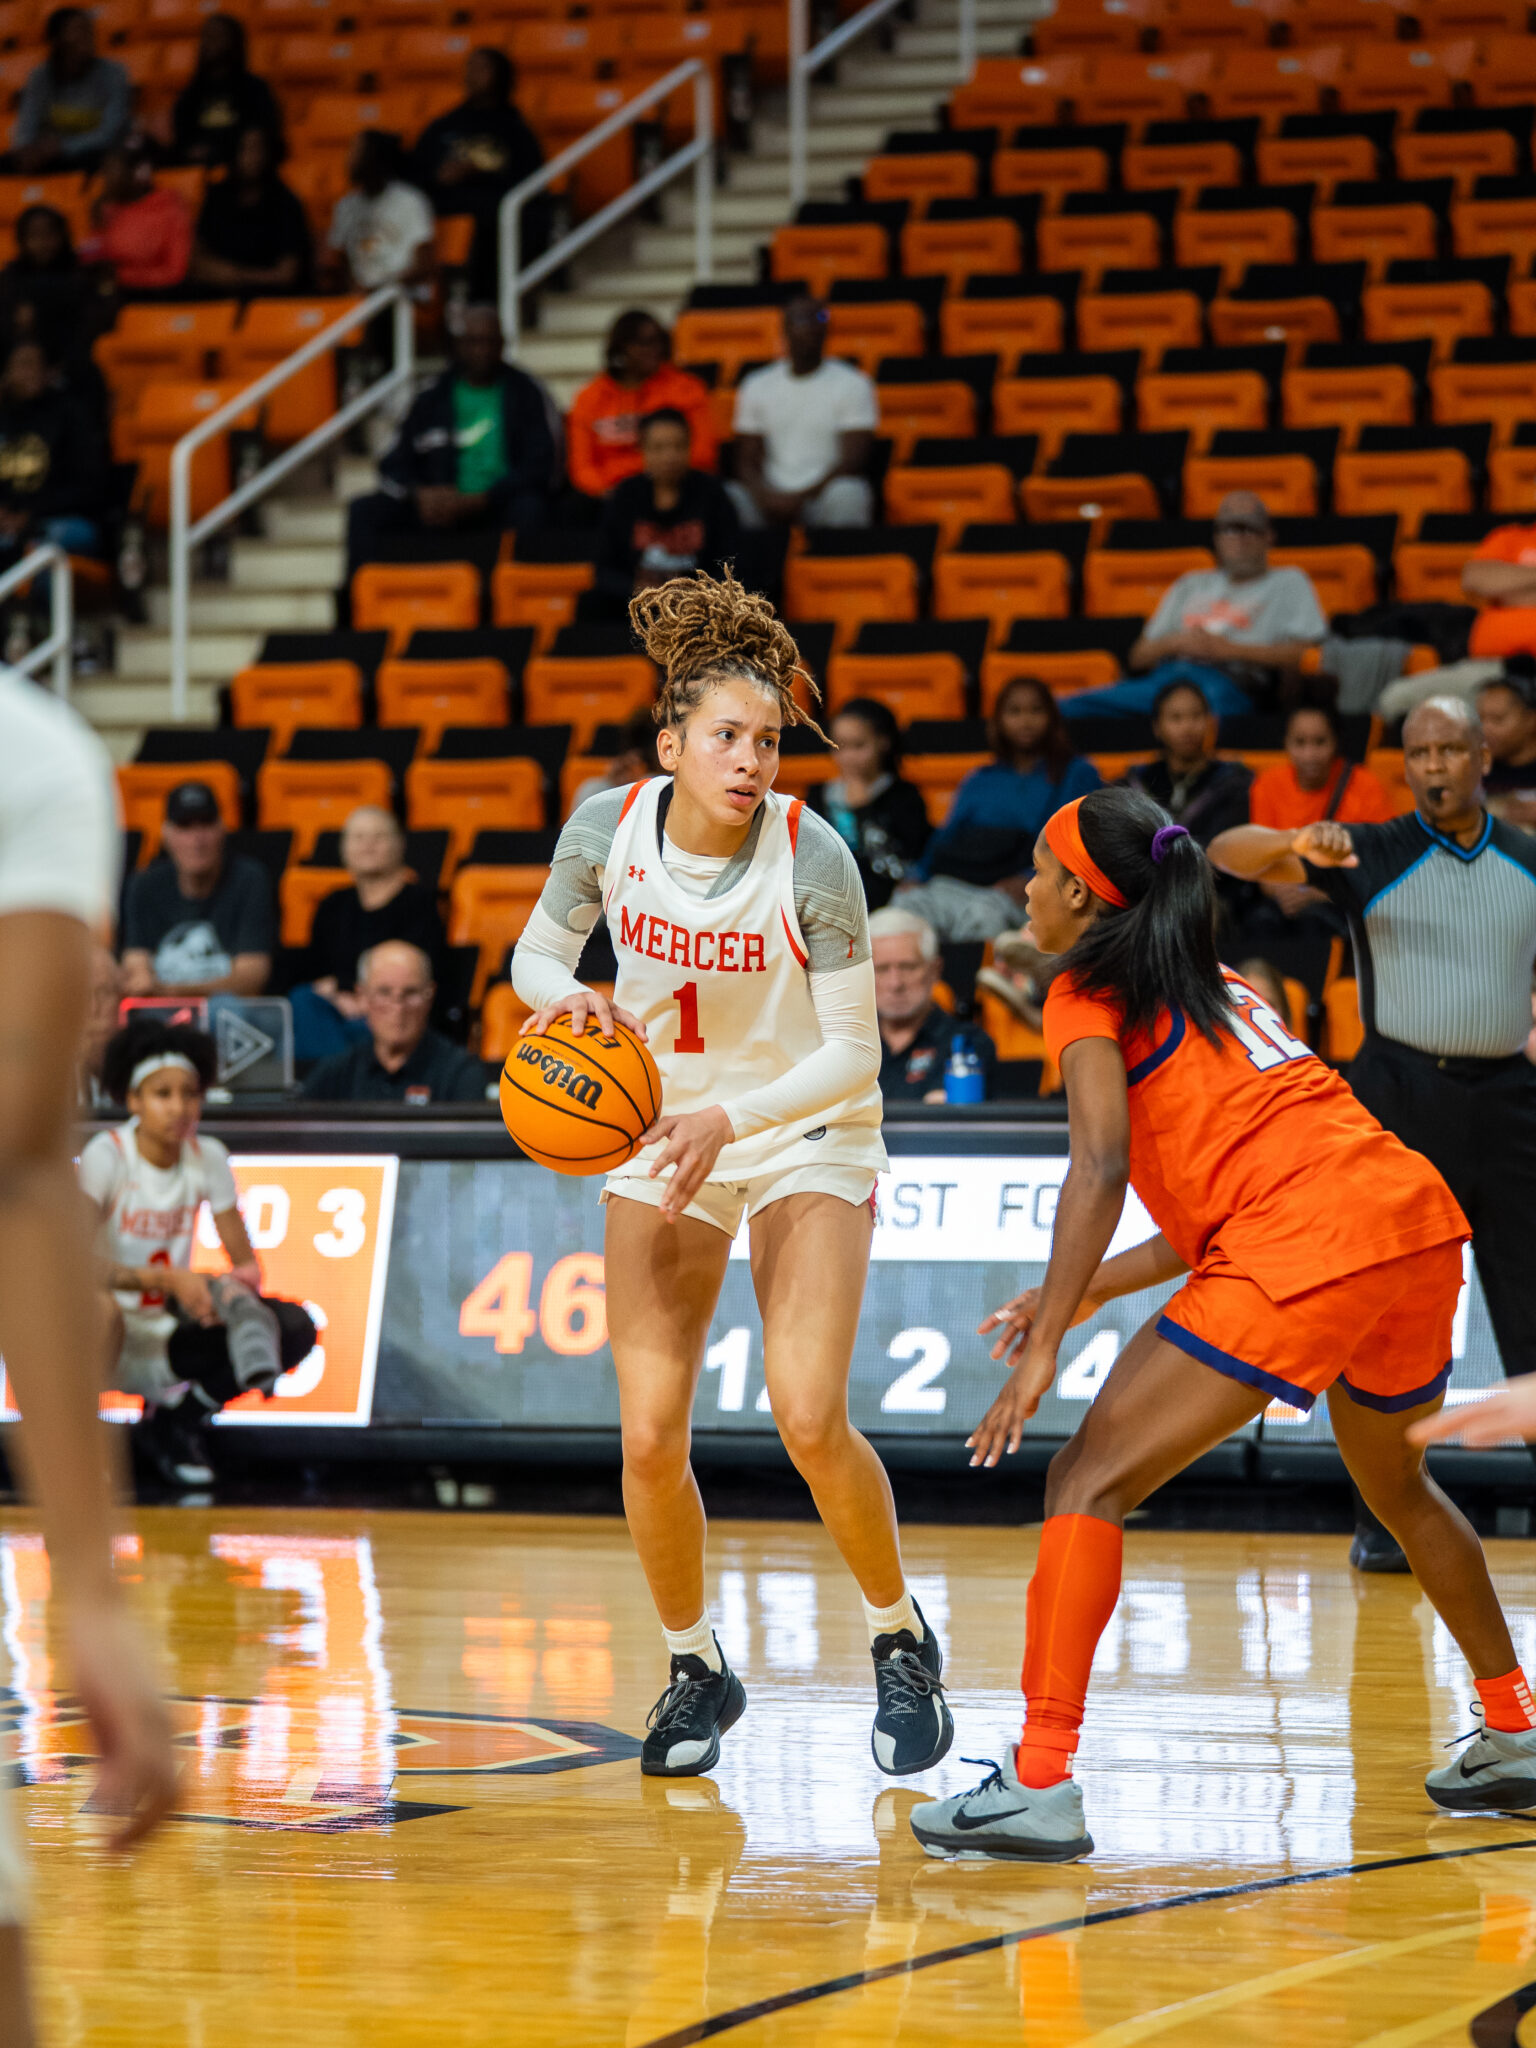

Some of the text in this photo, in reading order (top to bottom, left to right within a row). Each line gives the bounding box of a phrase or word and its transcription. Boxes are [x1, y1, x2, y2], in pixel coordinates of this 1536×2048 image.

[620, 904, 767, 973] MERCER
[672, 981, 705, 1054] 1
[516, 1042, 603, 1111] Wilson
[312, 1186, 366, 1258] 3
[458, 1251, 610, 1356] 46
[705, 1327, 772, 1412] 1
[880, 1326, 951, 1415] 2
